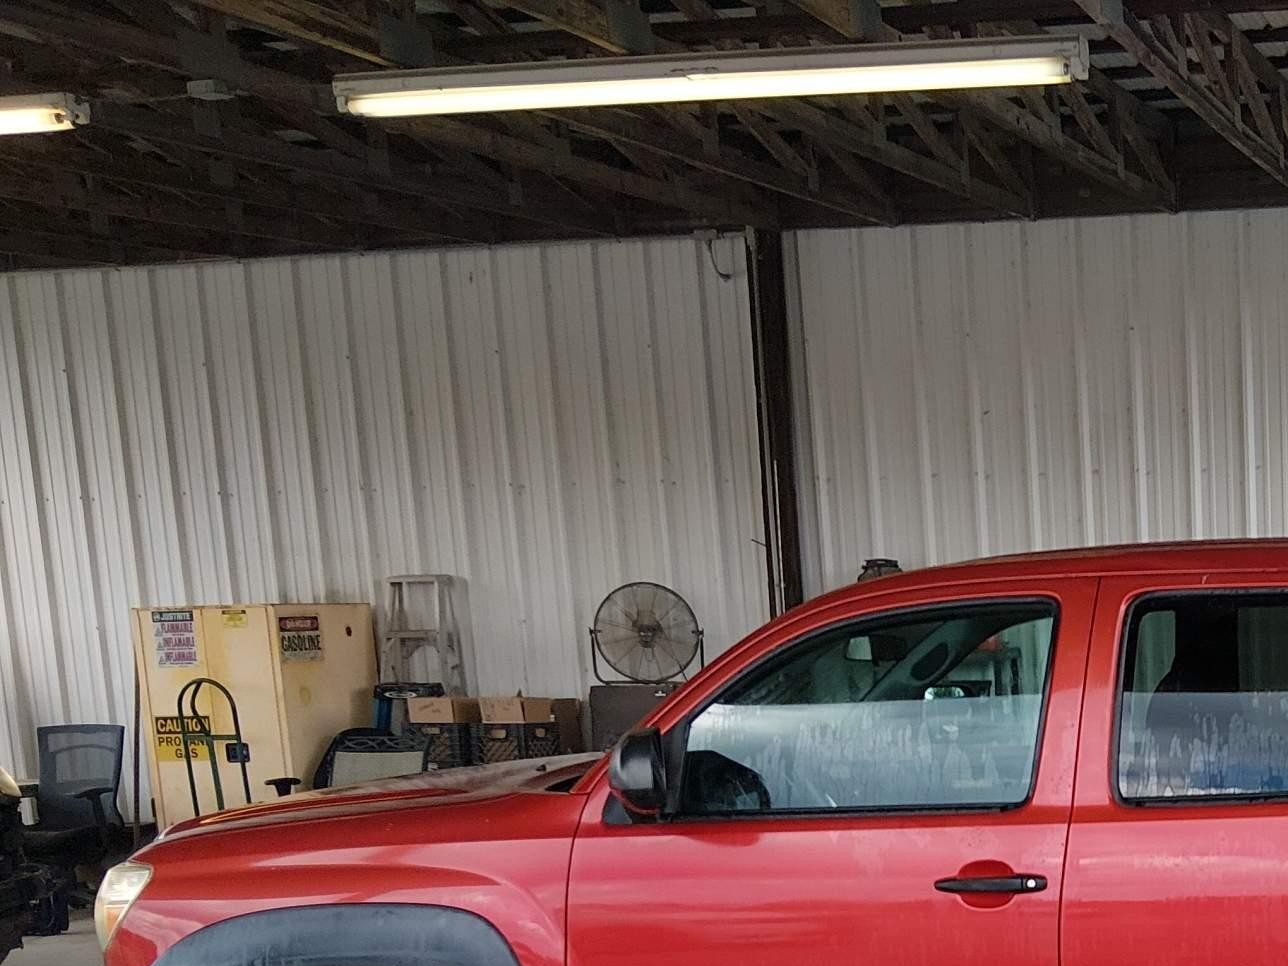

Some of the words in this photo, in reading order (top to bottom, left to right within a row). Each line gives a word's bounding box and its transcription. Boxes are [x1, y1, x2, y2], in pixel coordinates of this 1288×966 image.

[281, 634, 321, 651] GASOLINE
[158, 736, 209, 747] PROAN
[175, 748, 198, 758] GS
